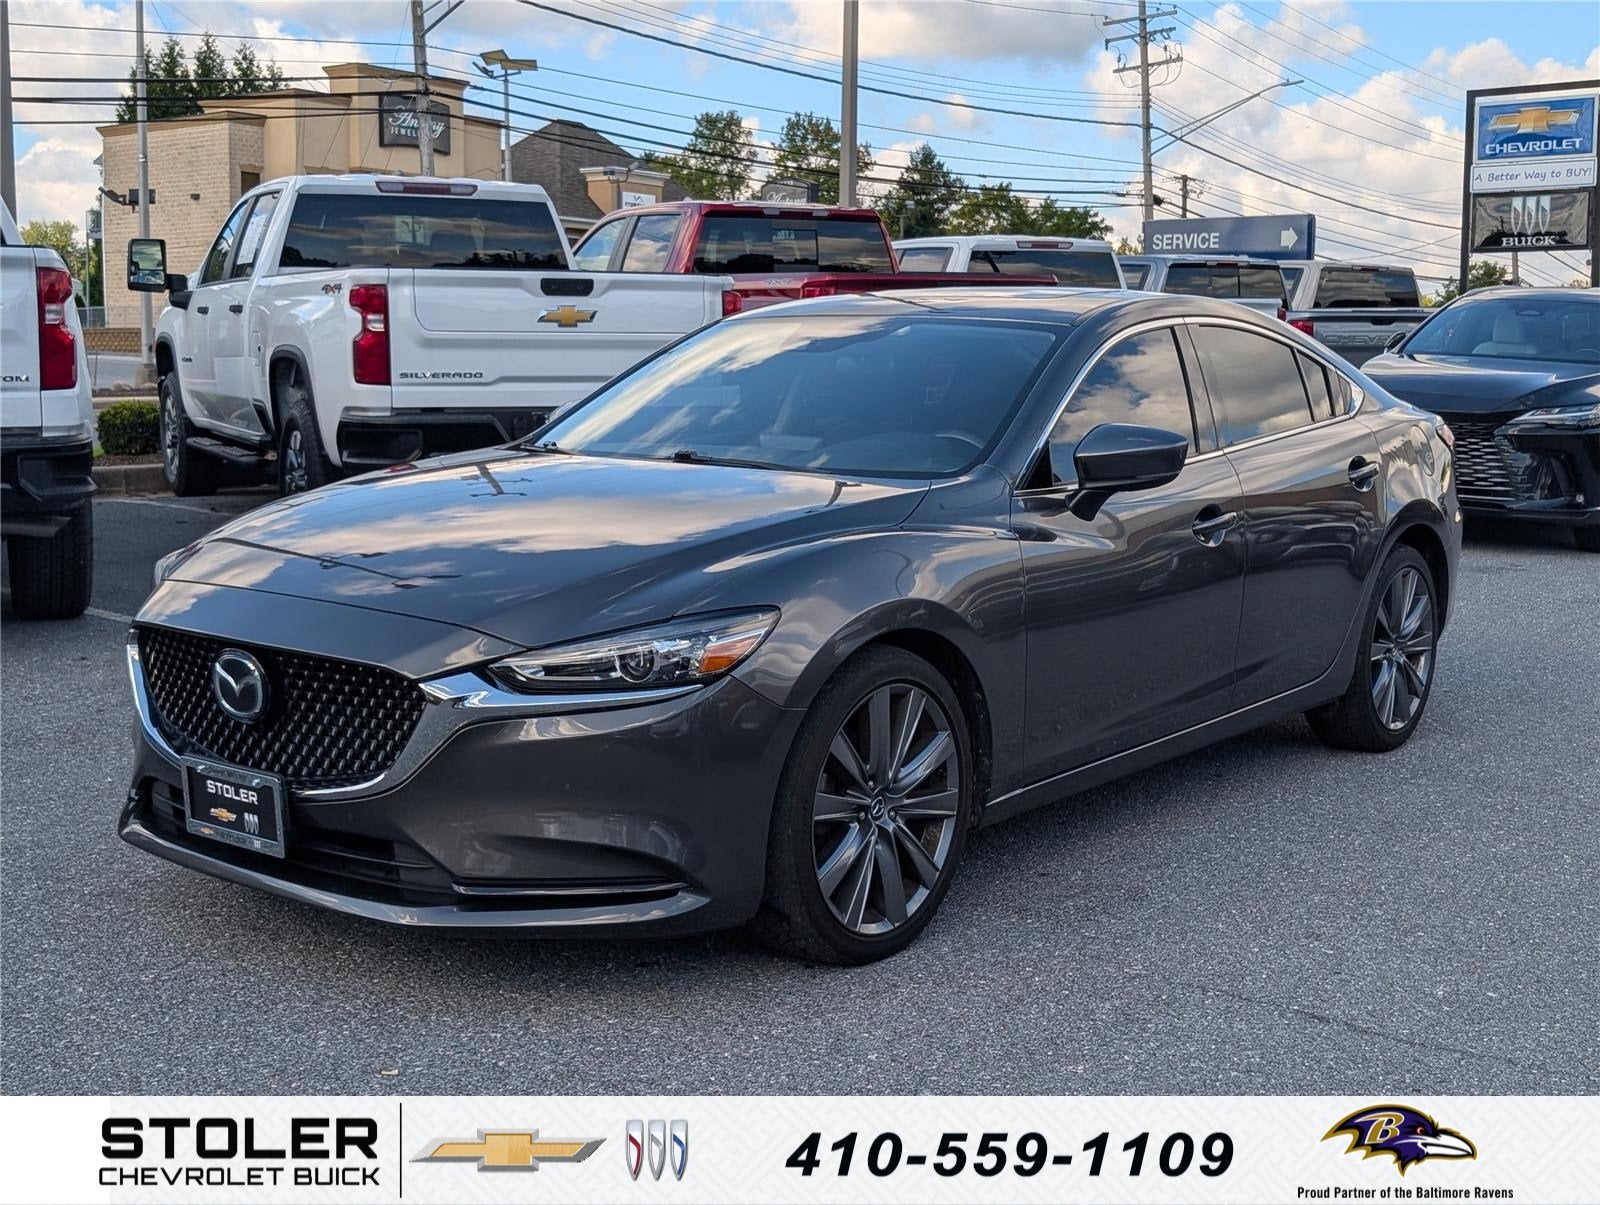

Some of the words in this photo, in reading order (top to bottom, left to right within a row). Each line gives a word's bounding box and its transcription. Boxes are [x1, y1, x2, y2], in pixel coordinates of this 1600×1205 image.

[388, 105, 446, 139] Any
[1485, 138, 1583, 155] CHEVROLET
[1474, 174, 1483, 182] A
[1487, 171, 1521, 182] Better
[1524, 170, 1547, 181] Way
[1550, 168, 1561, 178] to
[1565, 167, 1592, 178] BUY!
[1152, 232, 1220, 250] SERVICE
[1501, 236, 1556, 247] BUICK
[0, 375, 30, 383] OM
[206, 779, 259, 805] STOLER
